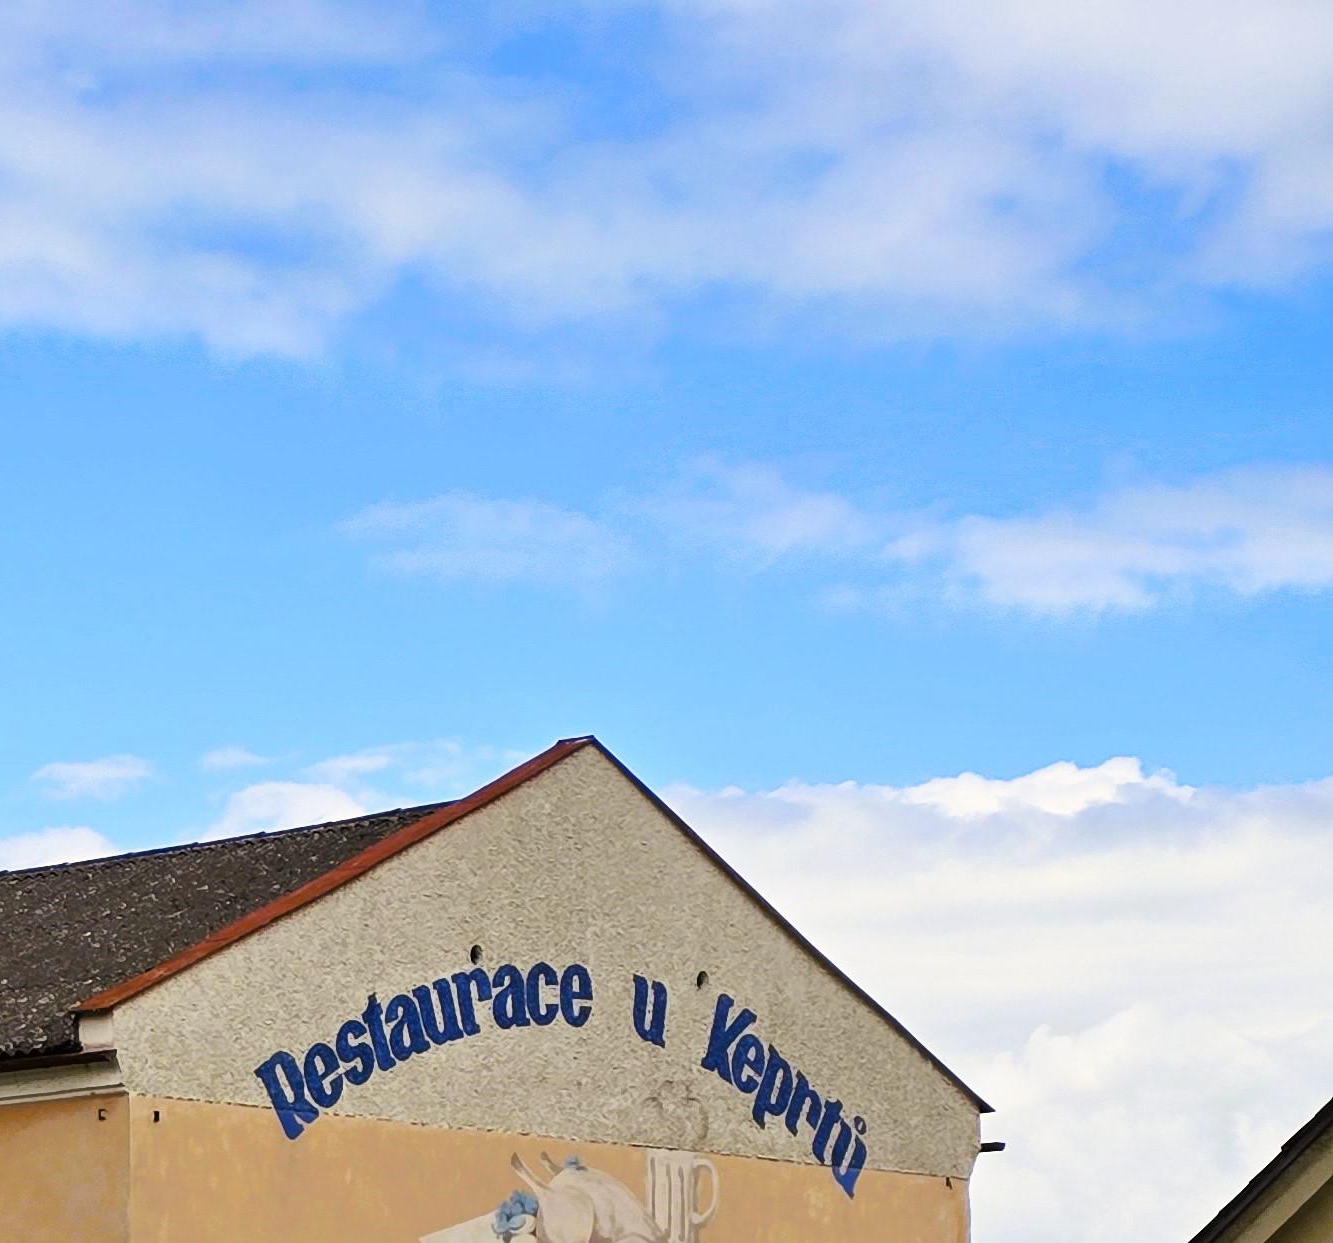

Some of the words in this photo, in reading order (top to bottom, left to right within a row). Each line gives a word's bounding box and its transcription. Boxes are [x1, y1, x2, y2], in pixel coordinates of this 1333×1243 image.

[254, 961, 594, 1141] Restaurace
[632, 973, 667, 1048] u
[701, 993, 869, 1199] Keprtů
